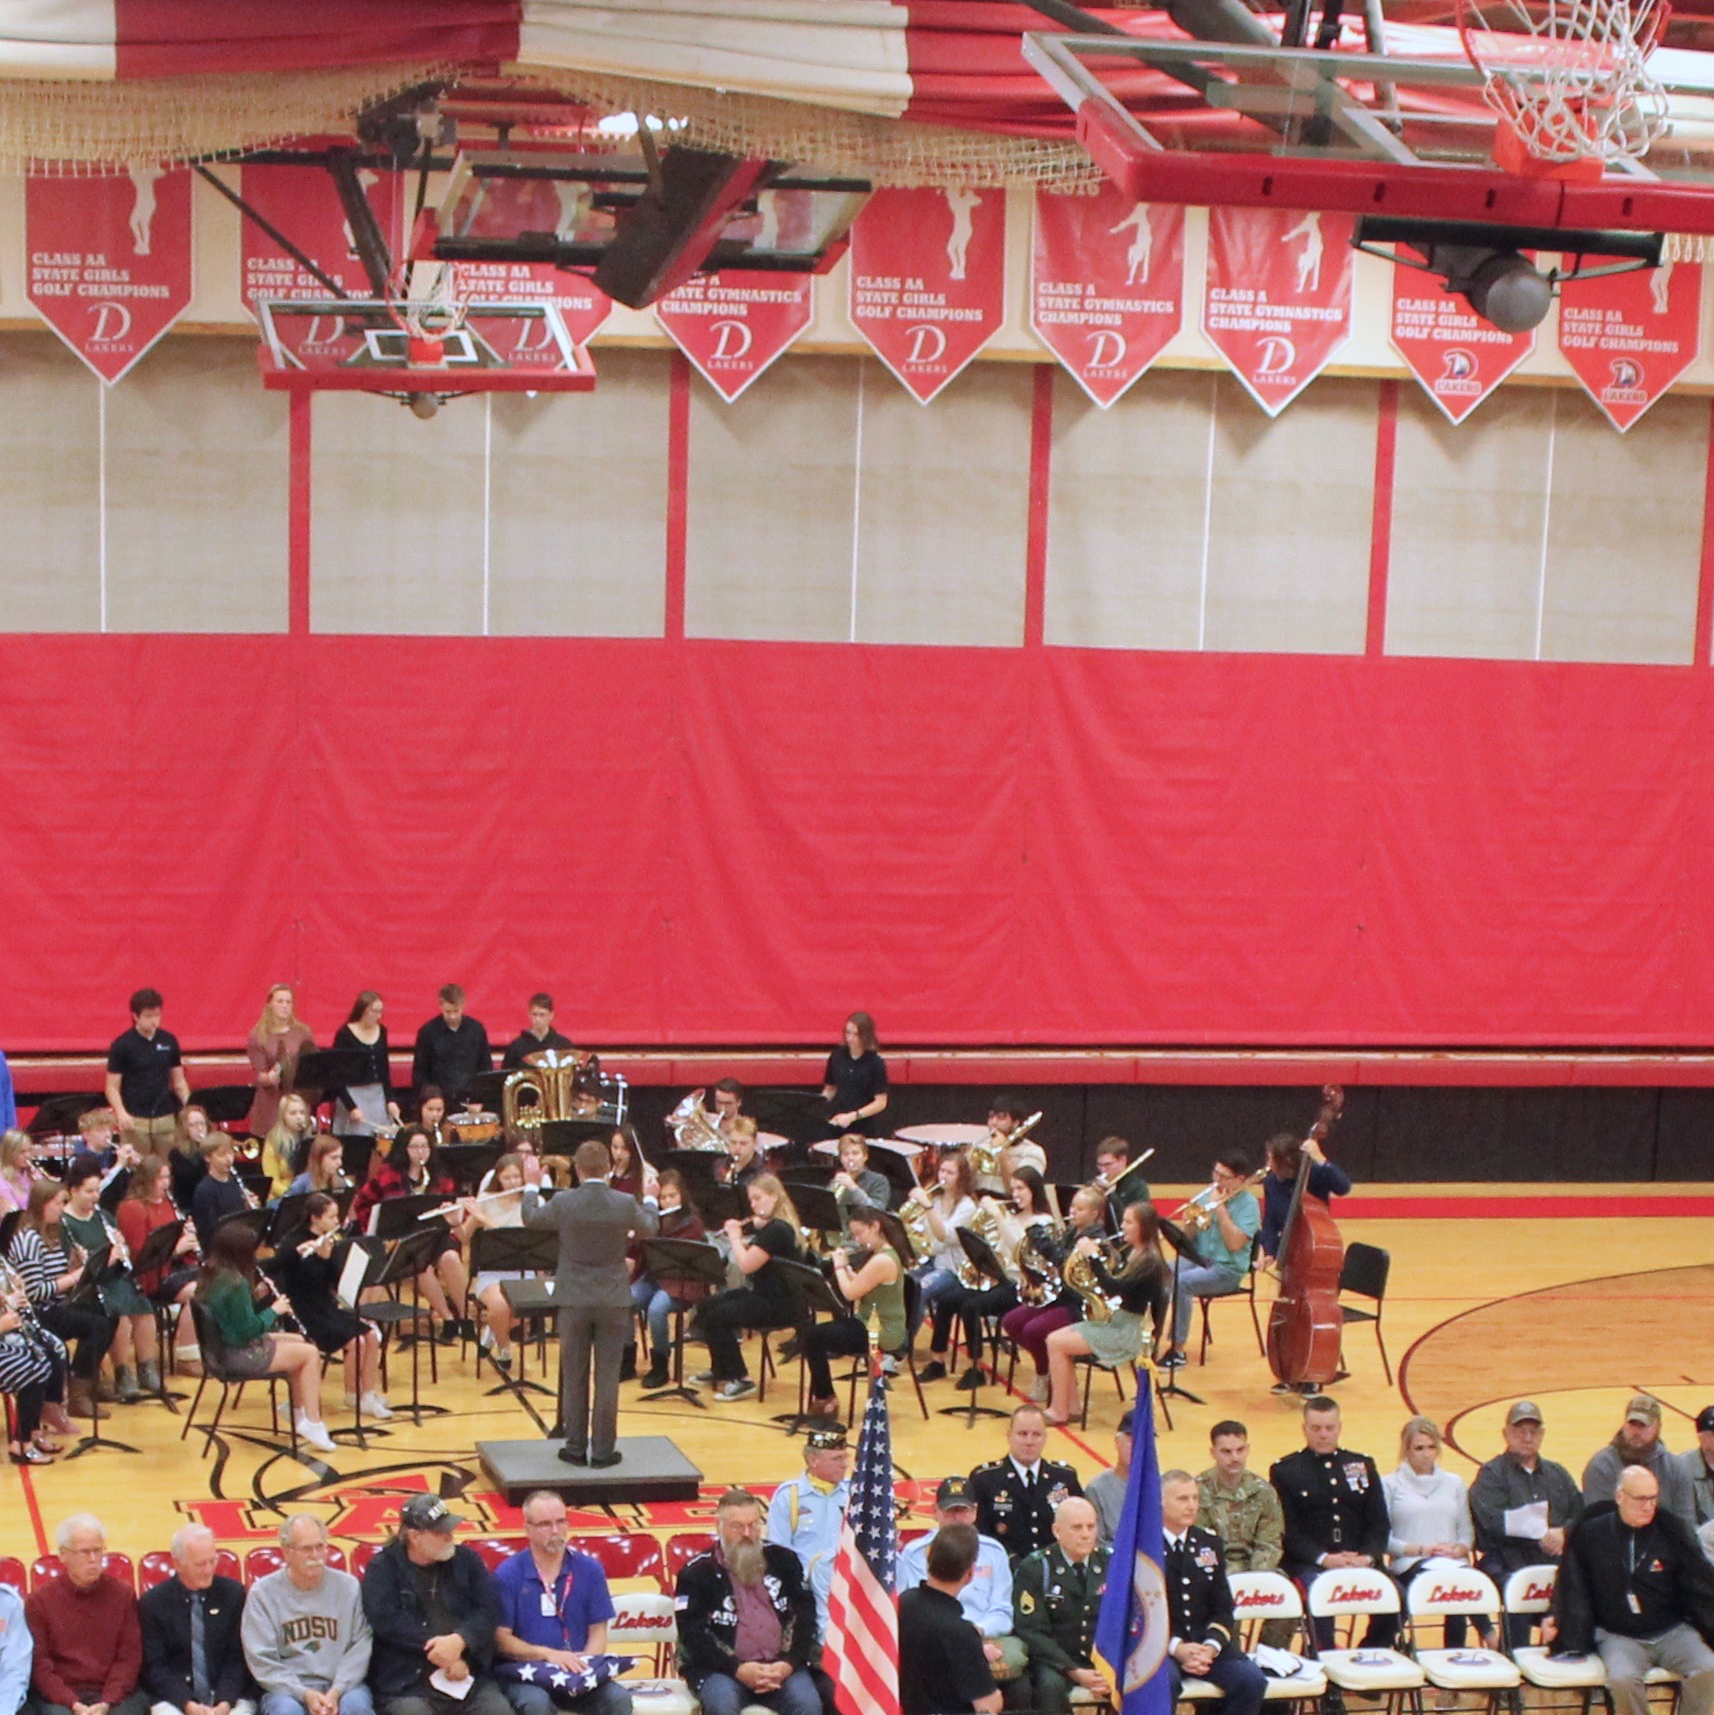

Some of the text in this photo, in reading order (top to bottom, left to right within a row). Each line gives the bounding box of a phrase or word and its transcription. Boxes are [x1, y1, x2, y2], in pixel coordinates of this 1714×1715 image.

[32, 252, 106, 267] CLASS AA
[246, 258, 295, 271] CLASS
[32, 267, 130, 282] STATE GIRLS
[510, 265, 531, 278] AA
[247, 273, 293, 286] STATE
[508, 281, 554, 293] GIRLS
[856, 276, 925, 291] CLASS AA
[32, 283, 170, 298] GOLF CHAMPIONS
[708, 288, 803, 303] GYMNASTICS
[1038, 282, 1096, 296] CLASS A
[1210, 288, 1267, 302] CLASS A
[856, 291, 946, 306] STATE GIRLS
[1038, 297, 1175, 314] STATE GYMNASTICS
[1397, 298, 1456, 313] CLASS AA
[661, 302, 748, 316] CHAMPIONS
[856, 305, 983, 321] GOLF CHAMPIONS
[1209, 303, 1343, 321] STATE GYMNASTICS
[1564, 307, 1623, 322] CLASS AA
[87, 301, 132, 342] D
[1038, 311, 1122, 326] CHAMPIONS
[1209, 317, 1292, 332] CHAMPIONS
[1396, 312, 1478, 328] STATE GIRLS
[1396, 326, 1430, 339] GOLF
[1563, 322, 1644, 337] STATE GIRLS
[710, 320, 752, 360] D
[905, 324, 946, 363] D
[1563, 335, 1679, 353] GOLF CHAMPIONS
[1086, 330, 1127, 369] D
[1256, 336, 1296, 374] D
[707, 360, 755, 370] LAKERS
[610, 1611, 674, 1631] Lakers
[282, 1616, 338, 1646] NDSU
